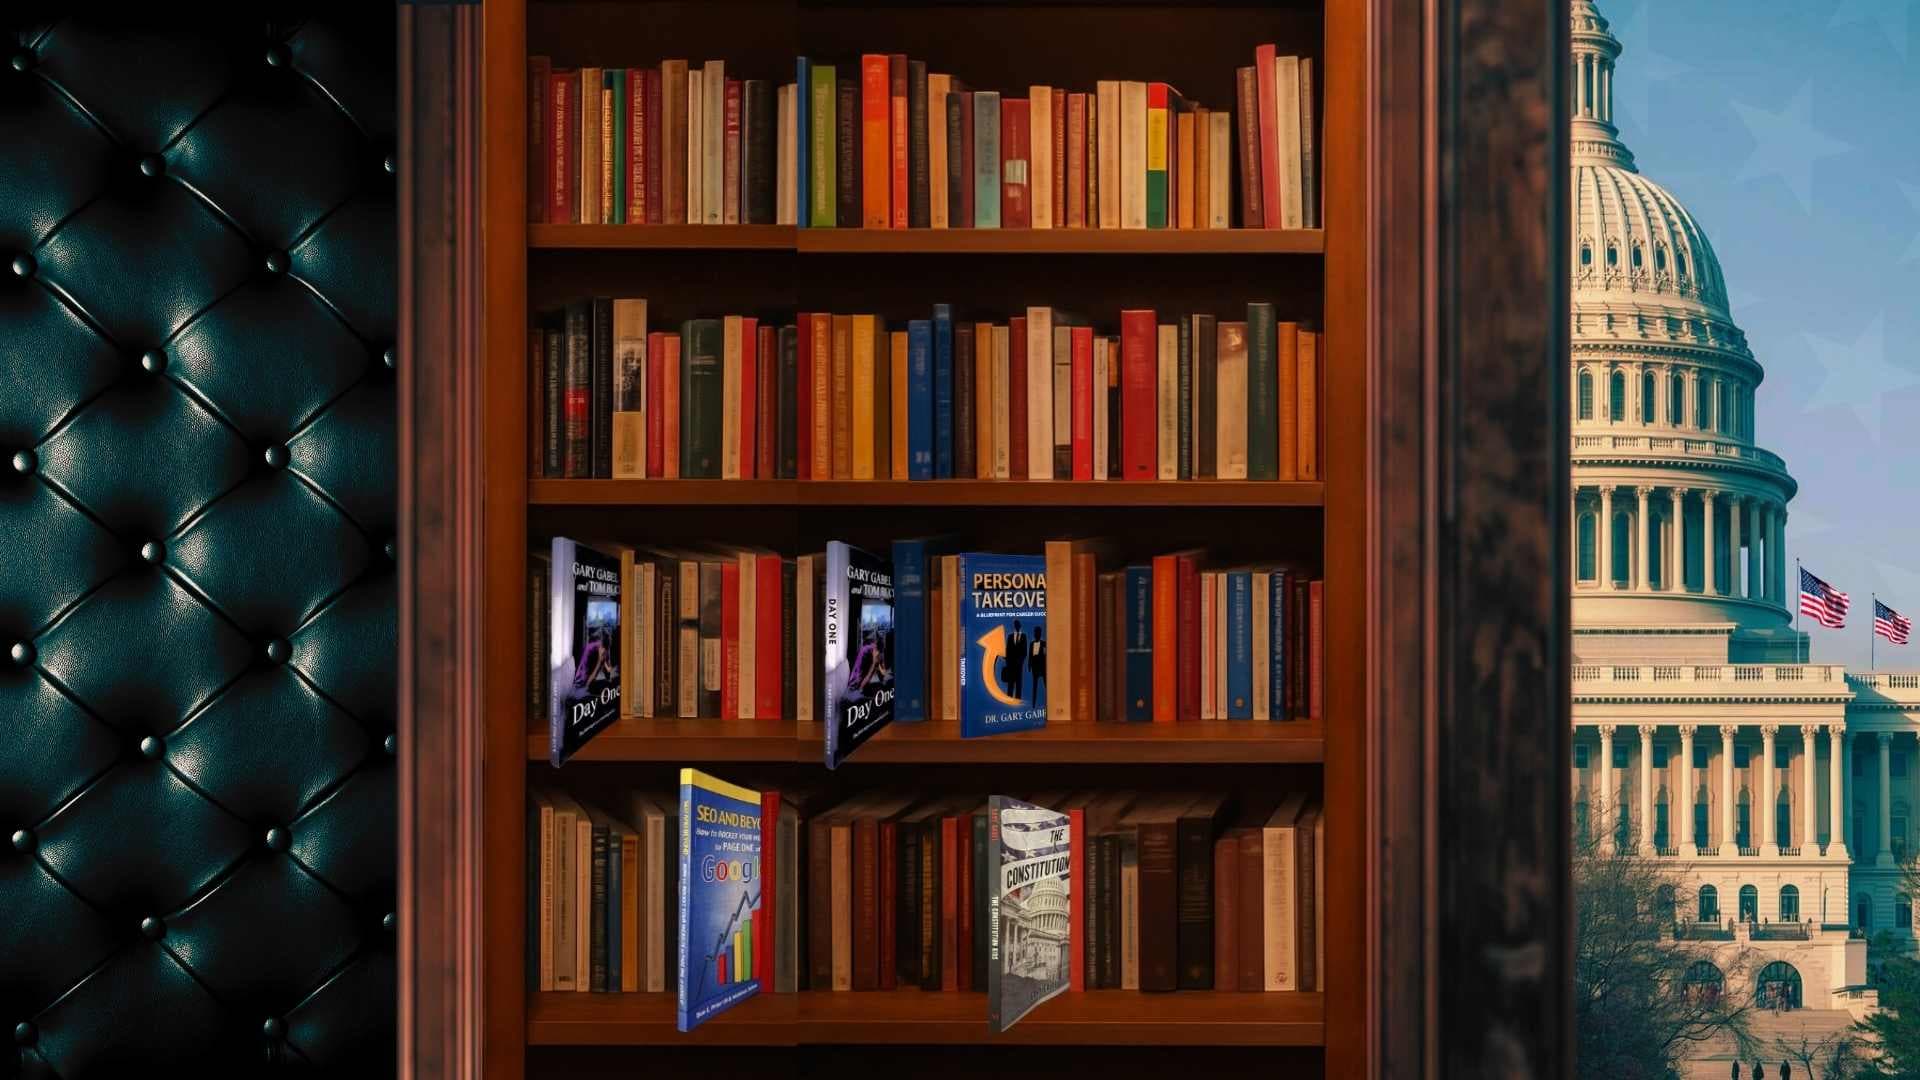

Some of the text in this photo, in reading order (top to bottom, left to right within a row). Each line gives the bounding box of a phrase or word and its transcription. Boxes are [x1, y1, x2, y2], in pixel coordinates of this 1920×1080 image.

[572, 561, 596, 579] GARY
[846, 564, 870, 581] GARY
[972, 591, 1046, 609] TAKEOVE
[828, 598, 837, 645] DAY ONE
[573, 697, 598, 725] Day
[847, 699, 872, 728] Day
[874, 687, 895, 707] One
[1000, 712, 1024, 722] GARY
[697, 804, 718, 823] SEO
[718, 810, 739, 826] AND
[1050, 828, 1065, 843] THE
[703, 854, 761, 884] Googl
[1006, 855, 1071, 889] CONSTITUTION
[991, 896, 999, 907] THE
